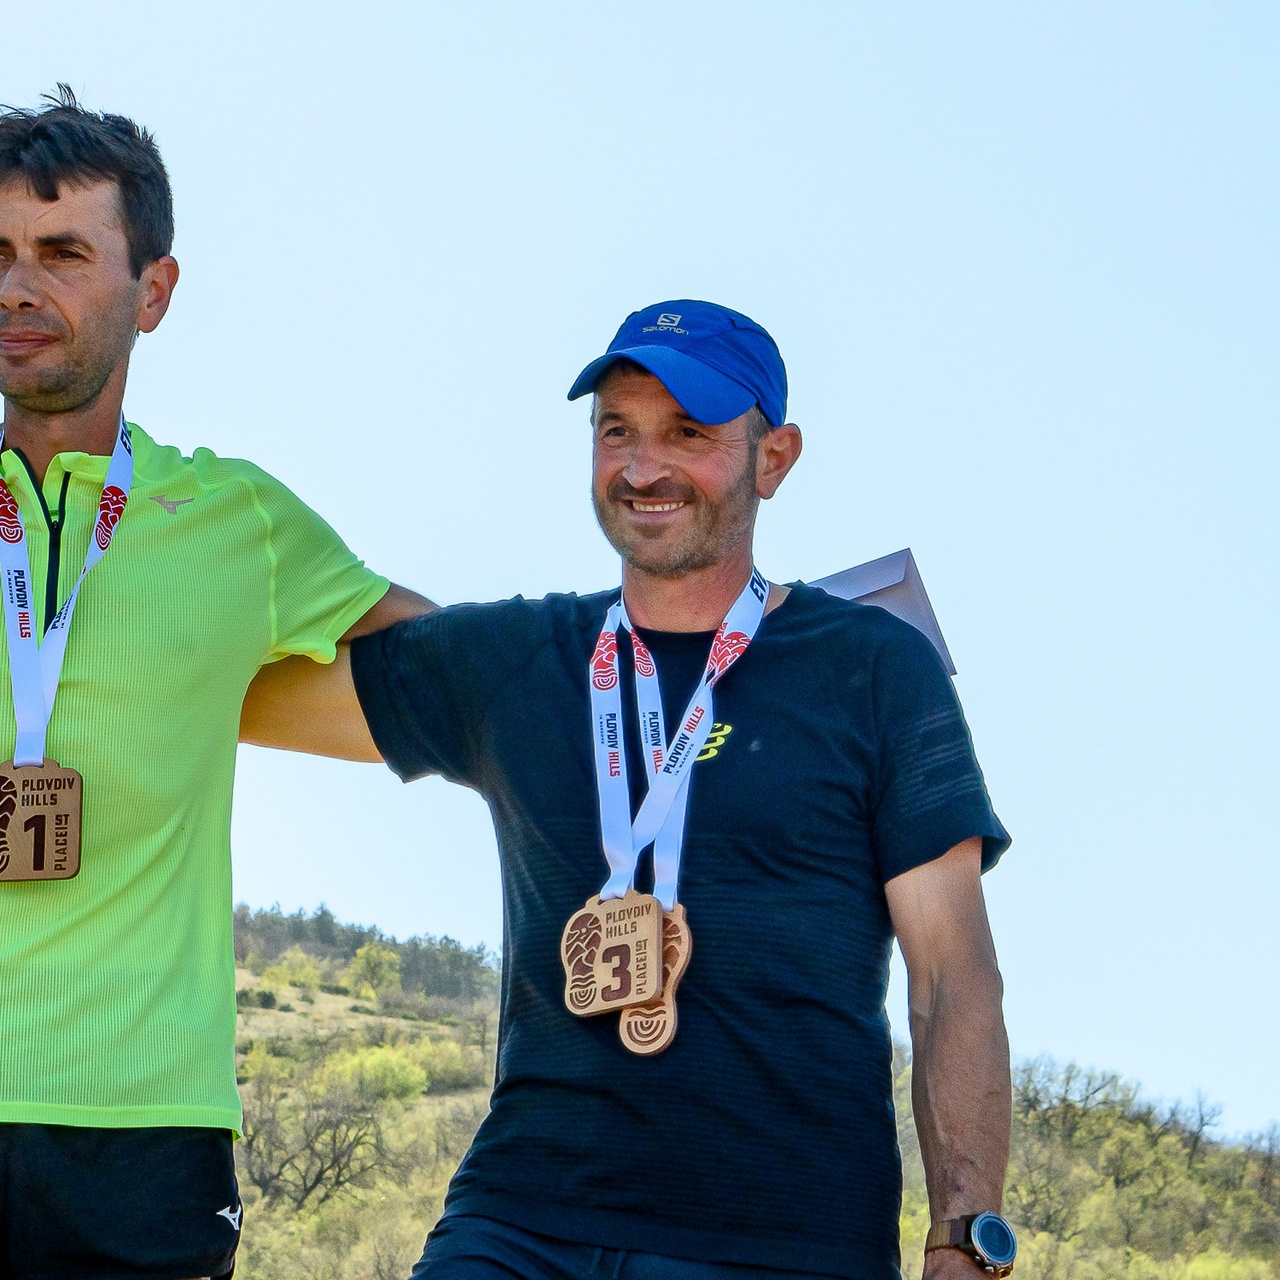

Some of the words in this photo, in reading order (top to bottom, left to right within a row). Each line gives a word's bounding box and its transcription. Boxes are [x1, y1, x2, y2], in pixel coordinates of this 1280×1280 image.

[13, 569, 29, 609] PLOVDIV
[18, 611, 31, 638] HILLS
[605, 713, 618, 749] PLOVDIV
[648, 711, 662, 747] PLOVDIV
[662, 733, 690, 774] PLOVDIV
[684, 706, 705, 733] HILLS
[608, 751, 620, 777] HILLS
[652, 749, 664, 775] HILL
[21, 777, 75, 792] PLOVDIV
[21, 793, 58, 807] HILLS
[23, 814, 46, 871] 1
[606, 903, 652, 925] PLOVDIV
[606, 921, 637, 939] HILLS
[601, 943, 632, 1002] 3
